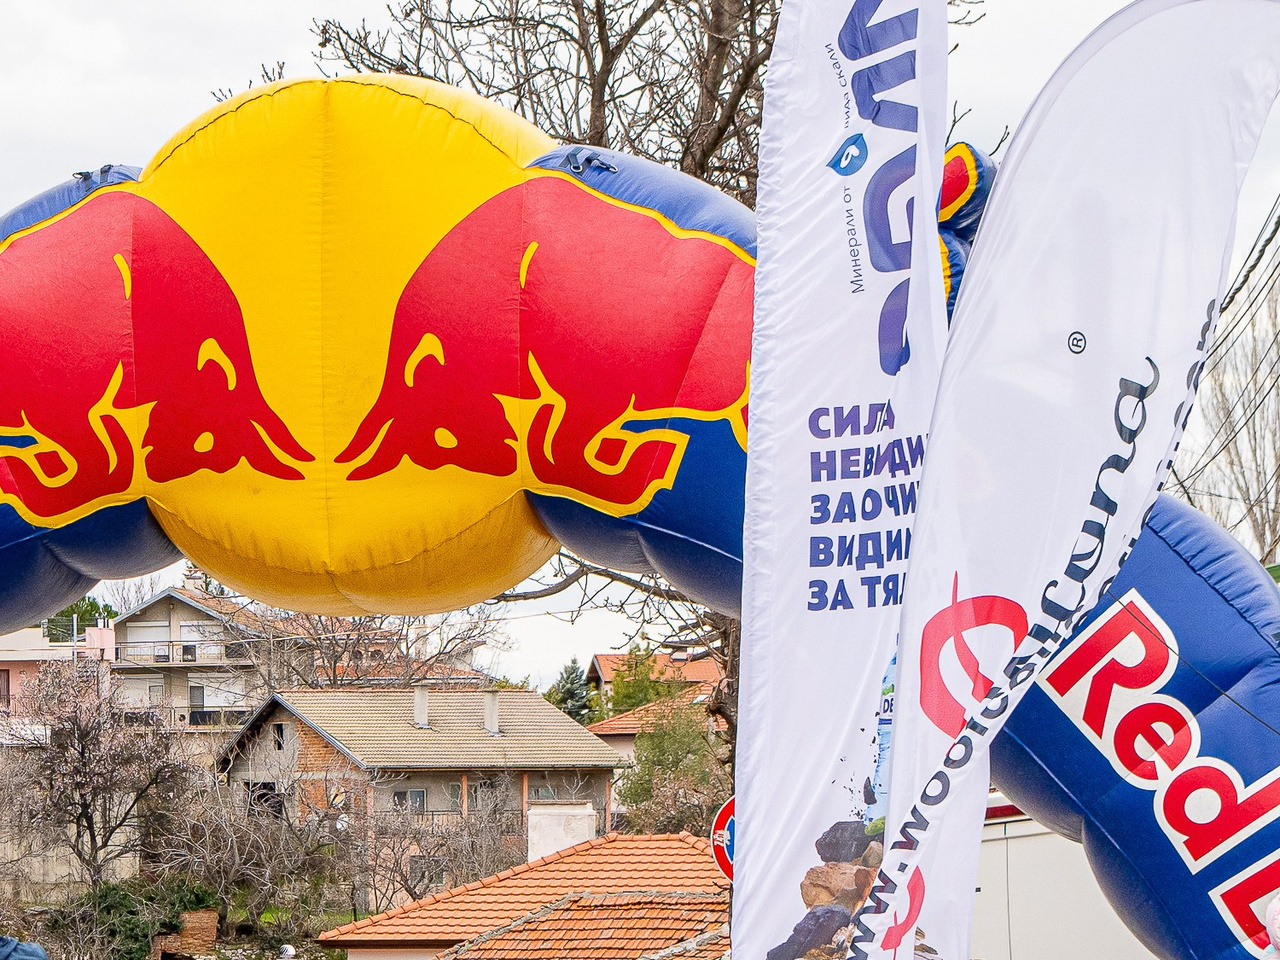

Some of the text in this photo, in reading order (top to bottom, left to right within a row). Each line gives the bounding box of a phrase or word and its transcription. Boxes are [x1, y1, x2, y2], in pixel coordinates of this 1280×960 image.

[843, 185, 853, 204] от
[844, 208, 865, 294] Минерали
[808, 399, 895, 440] СИЛА
[810, 433, 928, 482] НЕВИДИ
[861, 481, 919, 522] ОЧИ
[807, 573, 906, 611] ЗА ТЯ
[1046, 601, 1280, 861] Red
